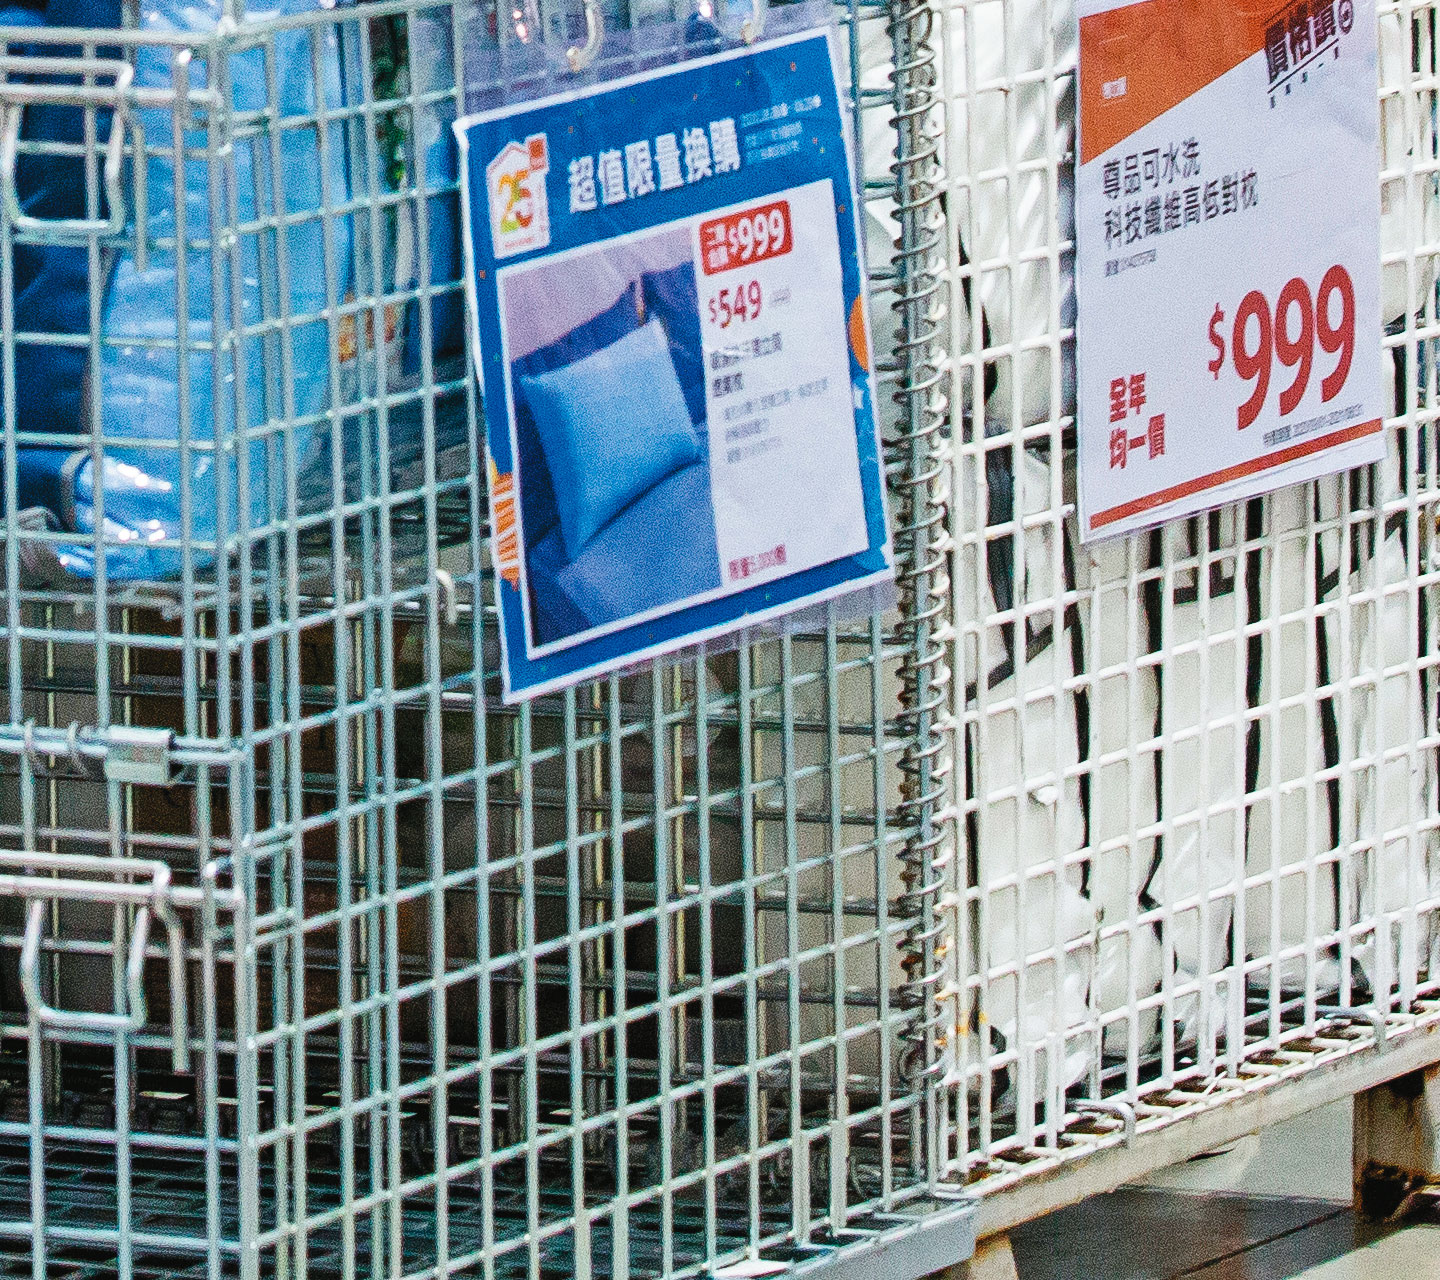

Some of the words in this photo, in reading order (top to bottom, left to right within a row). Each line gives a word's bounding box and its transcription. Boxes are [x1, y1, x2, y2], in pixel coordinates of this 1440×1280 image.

[567, 117, 743, 214] 超值限量換購
[1101, 136, 1201, 201] 尊品可水洗
[495, 168, 533, 237] 25
[728, 208, 786, 262] $999
[707, 279, 763, 329] $549
[1208, 263, 1357, 432] $999
